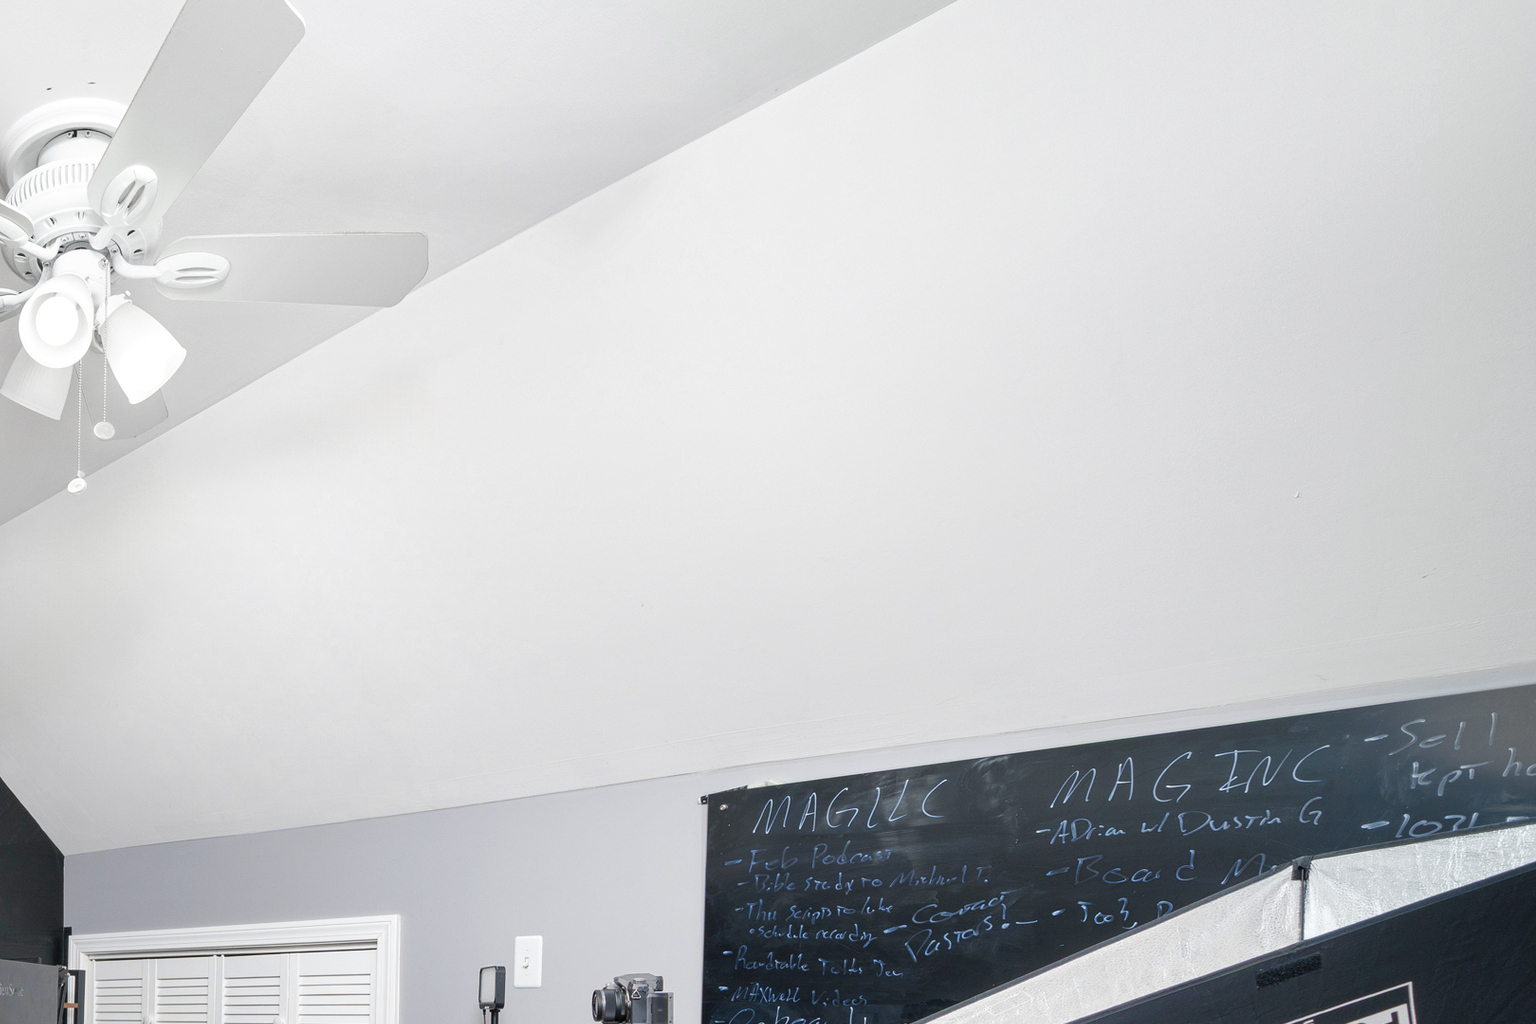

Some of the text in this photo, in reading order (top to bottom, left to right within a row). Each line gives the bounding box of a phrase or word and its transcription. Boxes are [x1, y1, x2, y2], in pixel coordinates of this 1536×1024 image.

[1050, 745, 1330, 808] MAG INC
[1299, 797, 1323, 825] G
[748, 846, 798, 873] Feb
[1075, 850, 1197, 885] Board
